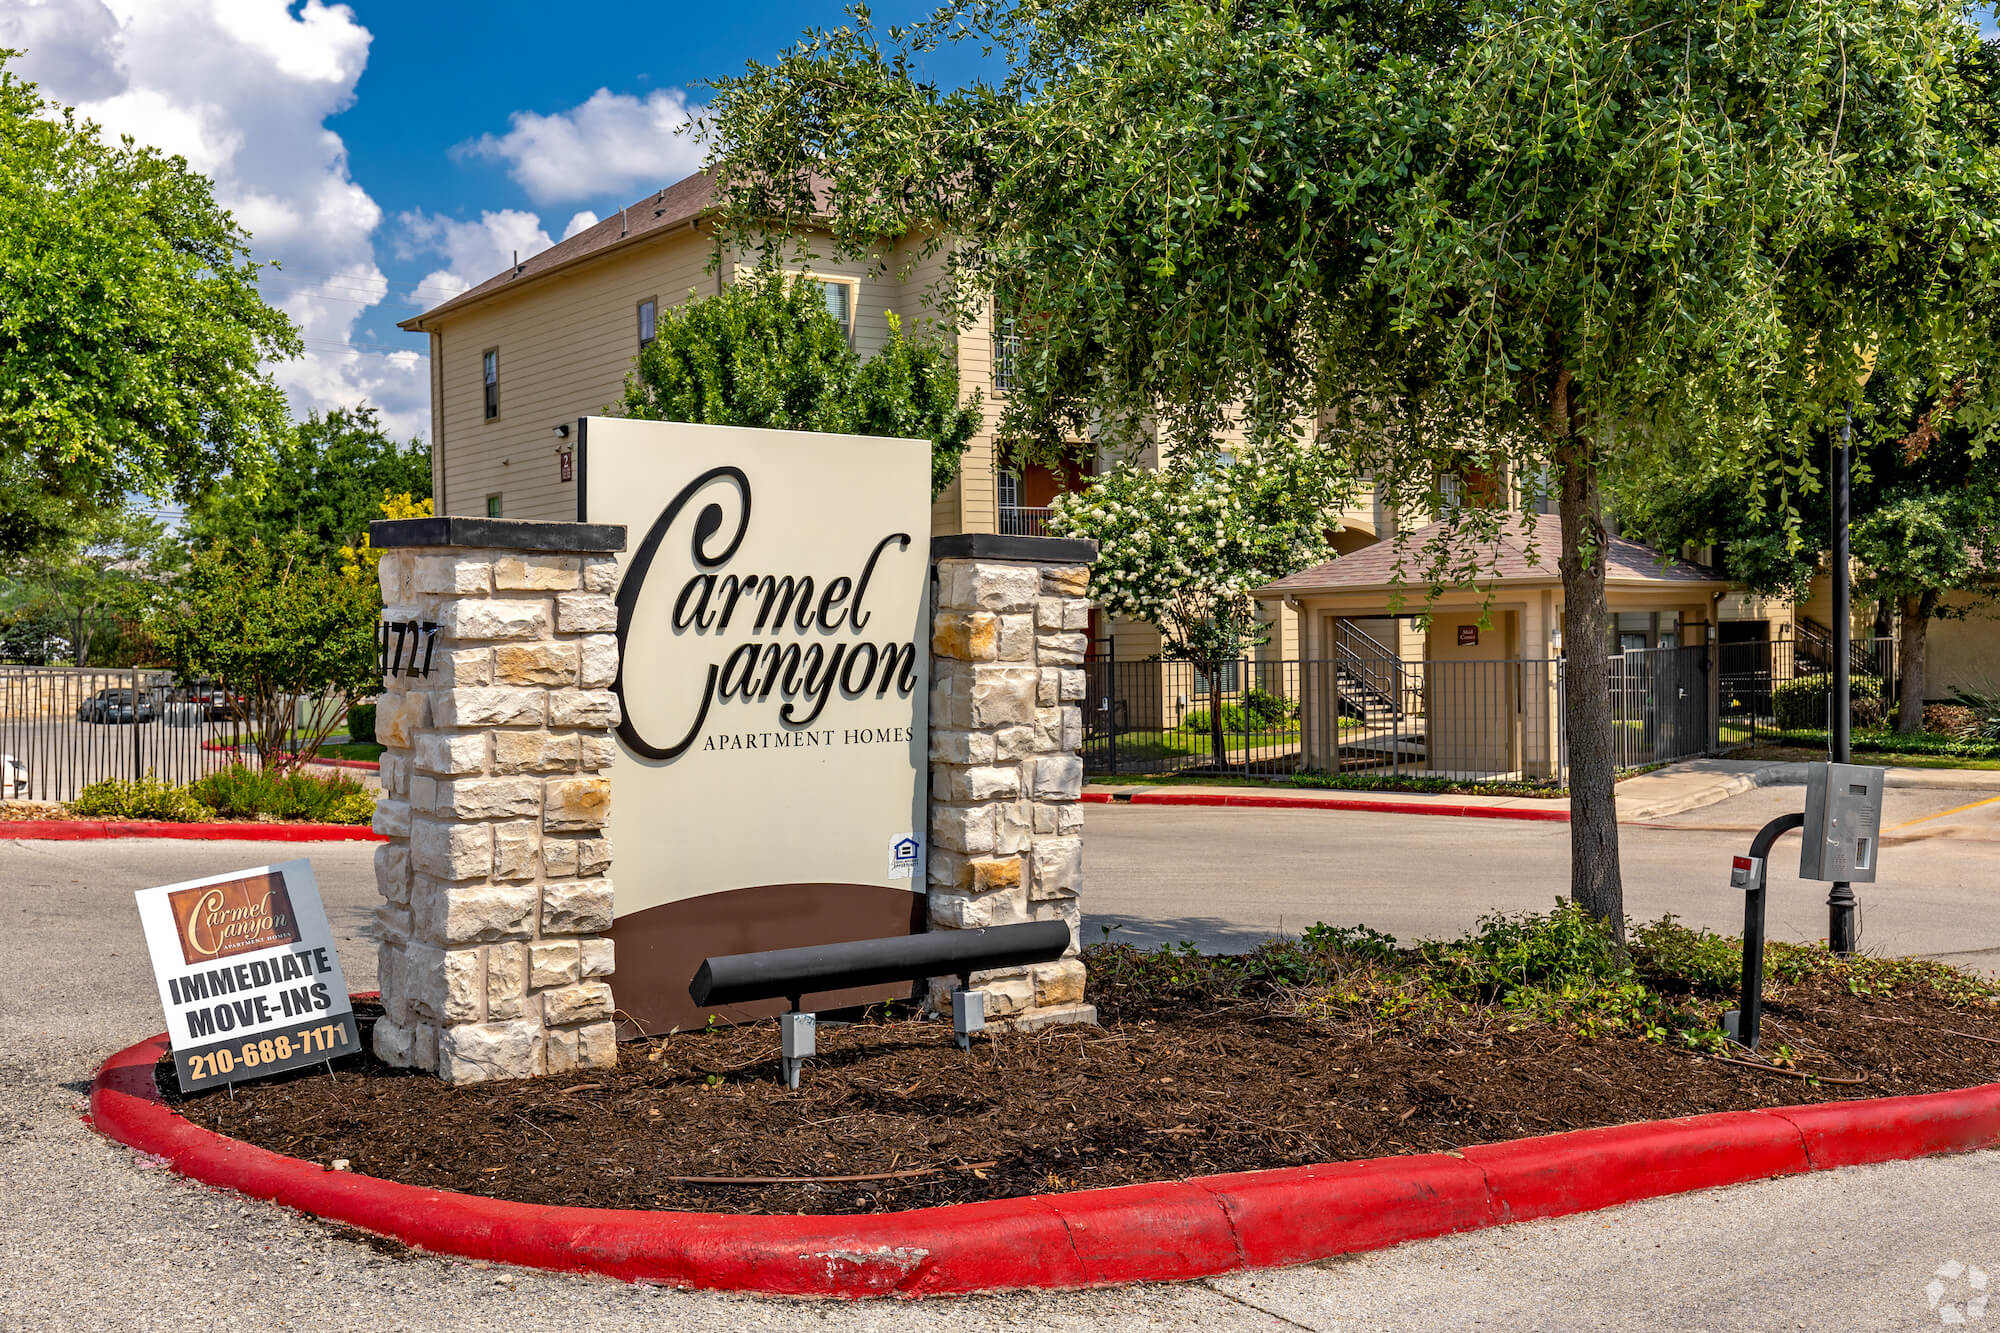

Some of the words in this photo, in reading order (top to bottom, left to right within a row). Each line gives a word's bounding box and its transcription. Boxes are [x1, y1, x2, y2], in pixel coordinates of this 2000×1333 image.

[563, 454, 569, 468] 2
[616, 465, 912, 636] Carmel
[704, 730, 835, 751] APARTMENT
[843, 725, 915, 747] HOMES
[223, 938, 266, 950] APARTMENT
[266, 931, 292, 943] HOMES
[168, 947, 332, 1006] IMMEDIATE
[185, 982, 332, 1039] MOVE-INS
[188, 1022, 350, 1081] 210-688-7171
